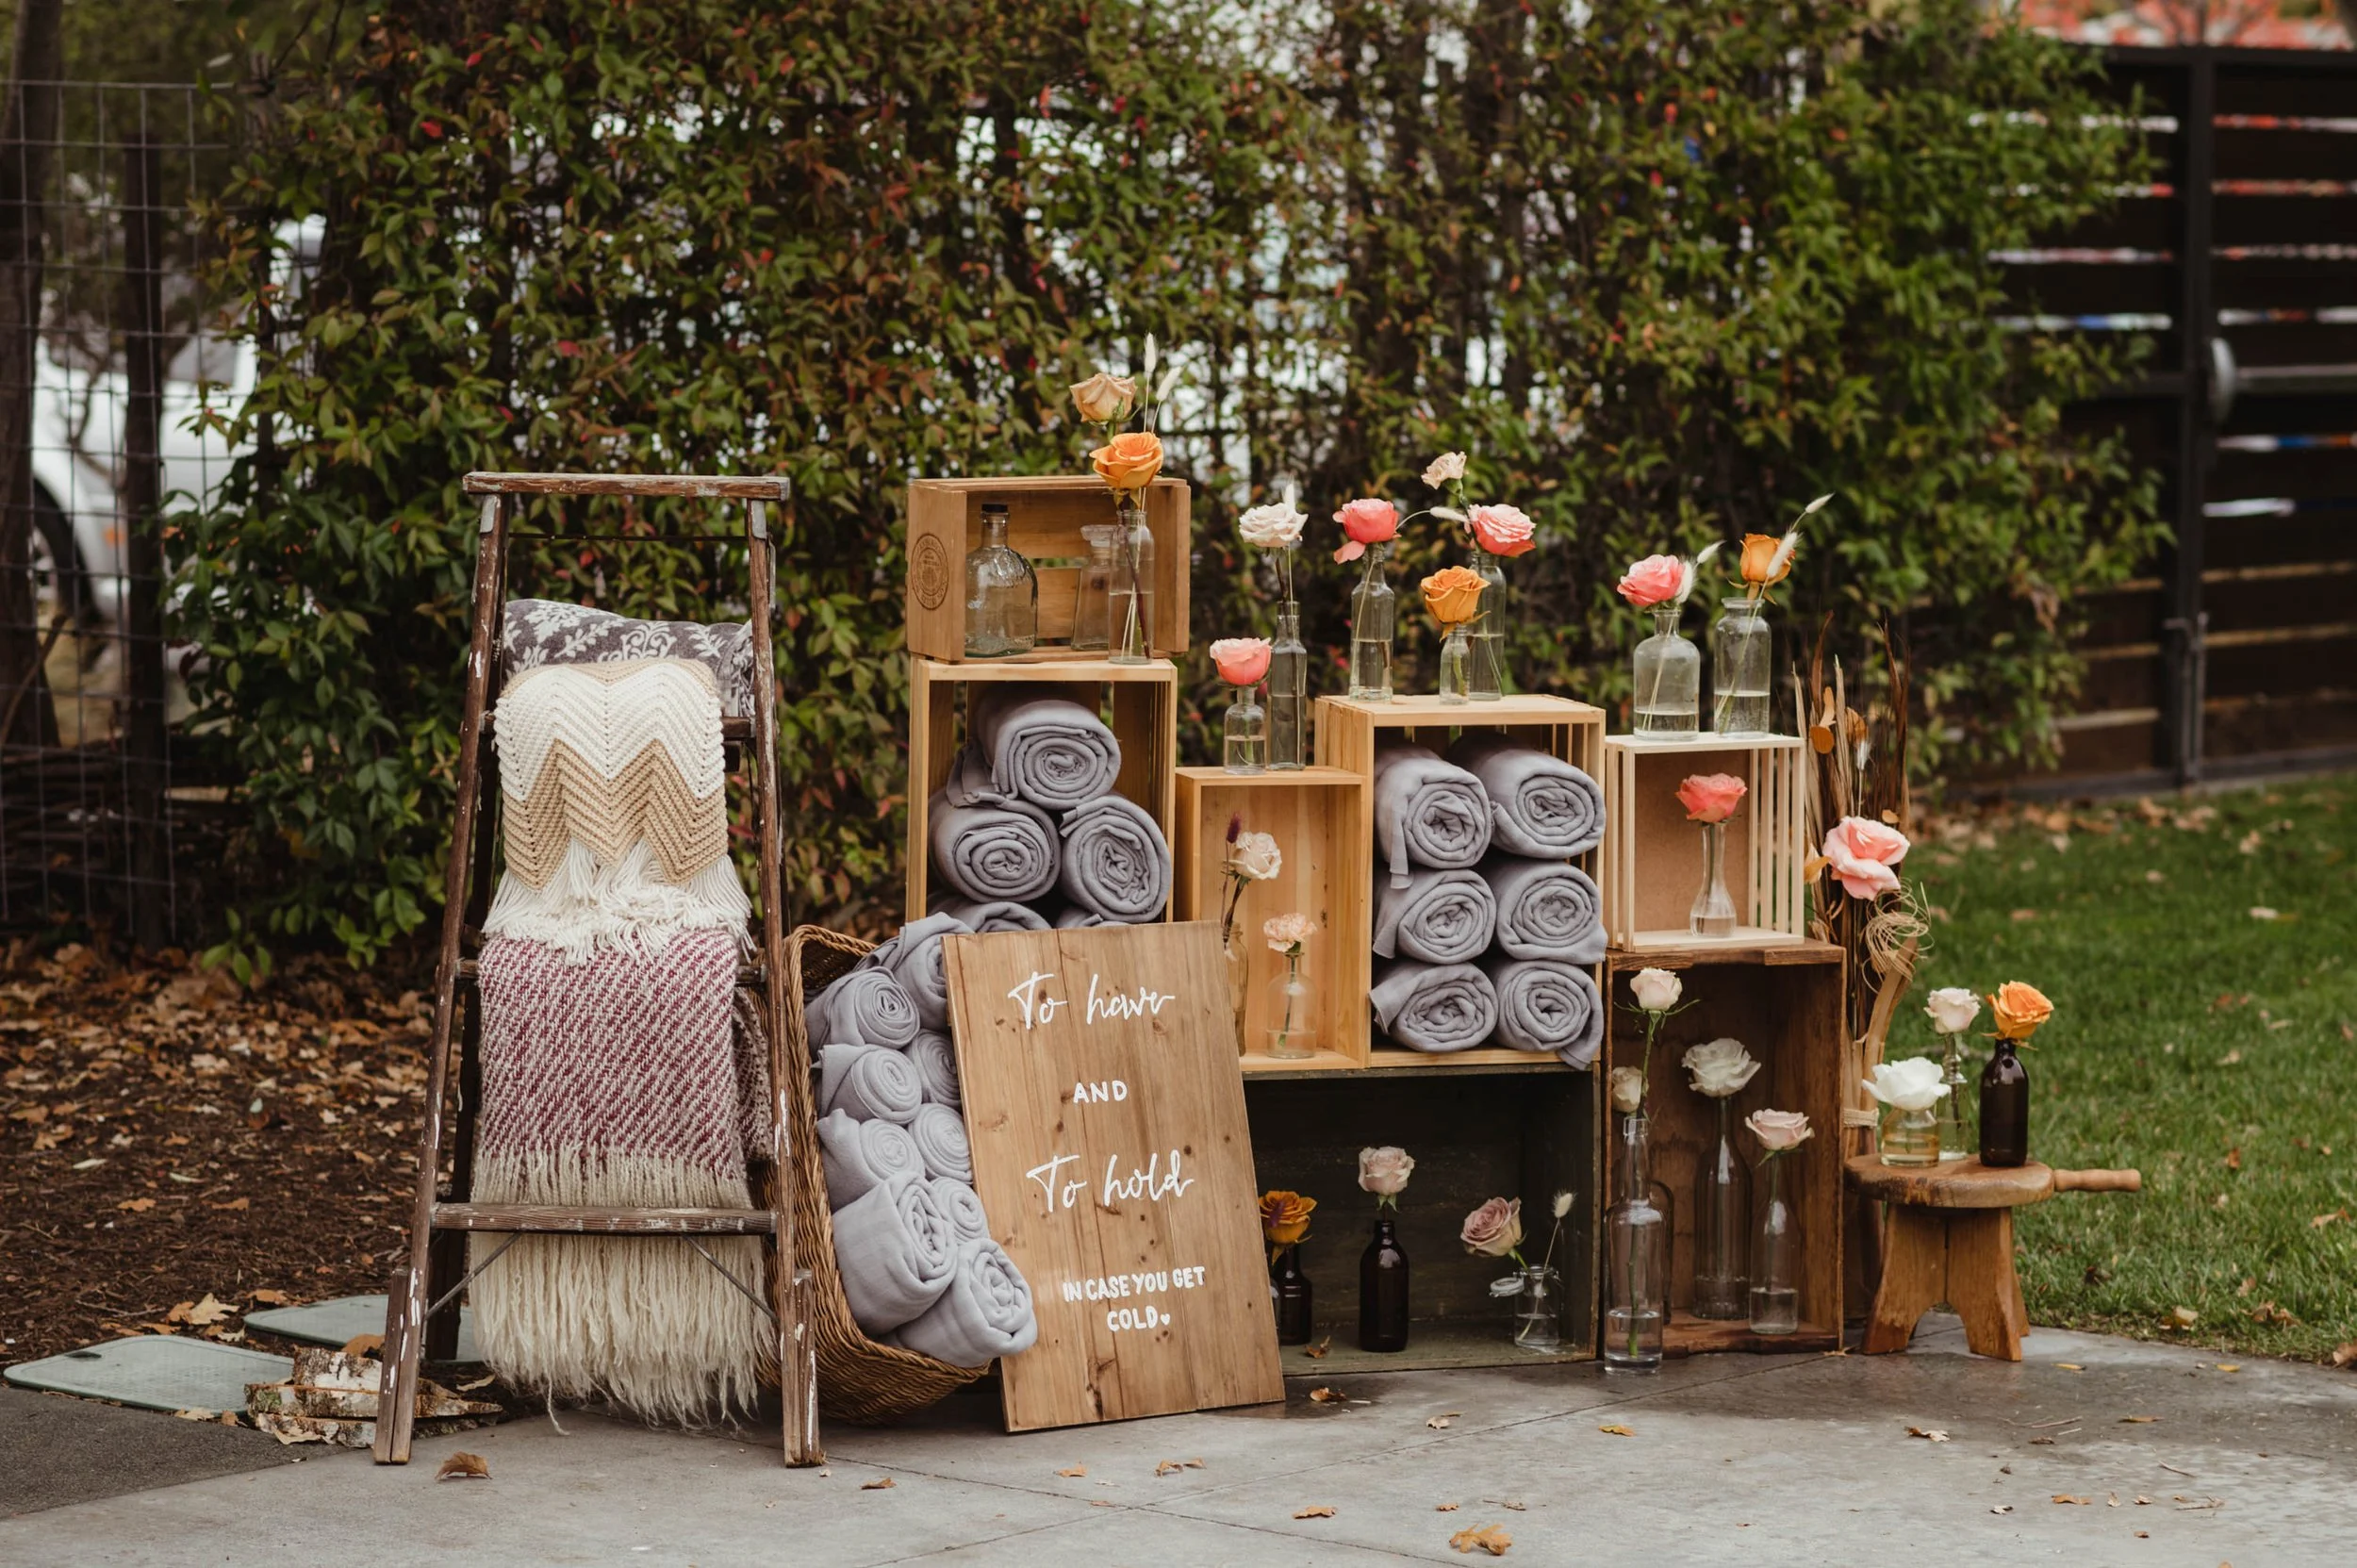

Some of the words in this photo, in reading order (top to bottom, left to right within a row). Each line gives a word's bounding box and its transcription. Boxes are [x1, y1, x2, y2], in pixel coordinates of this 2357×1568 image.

[1008, 971, 1068, 1030] To
[1086, 973, 1176, 1025] have
[1073, 1081, 1128, 1103] AND
[1026, 1154, 1087, 1213] To
[1103, 1149, 1195, 1207] hold
[1063, 1281, 1082, 1302] IN
[1085, 1275, 1130, 1301] CASE
[1131, 1271, 1168, 1295] YOU
[1173, 1266, 1206, 1288] GET
[1107, 1306, 1159, 1331] COLD
